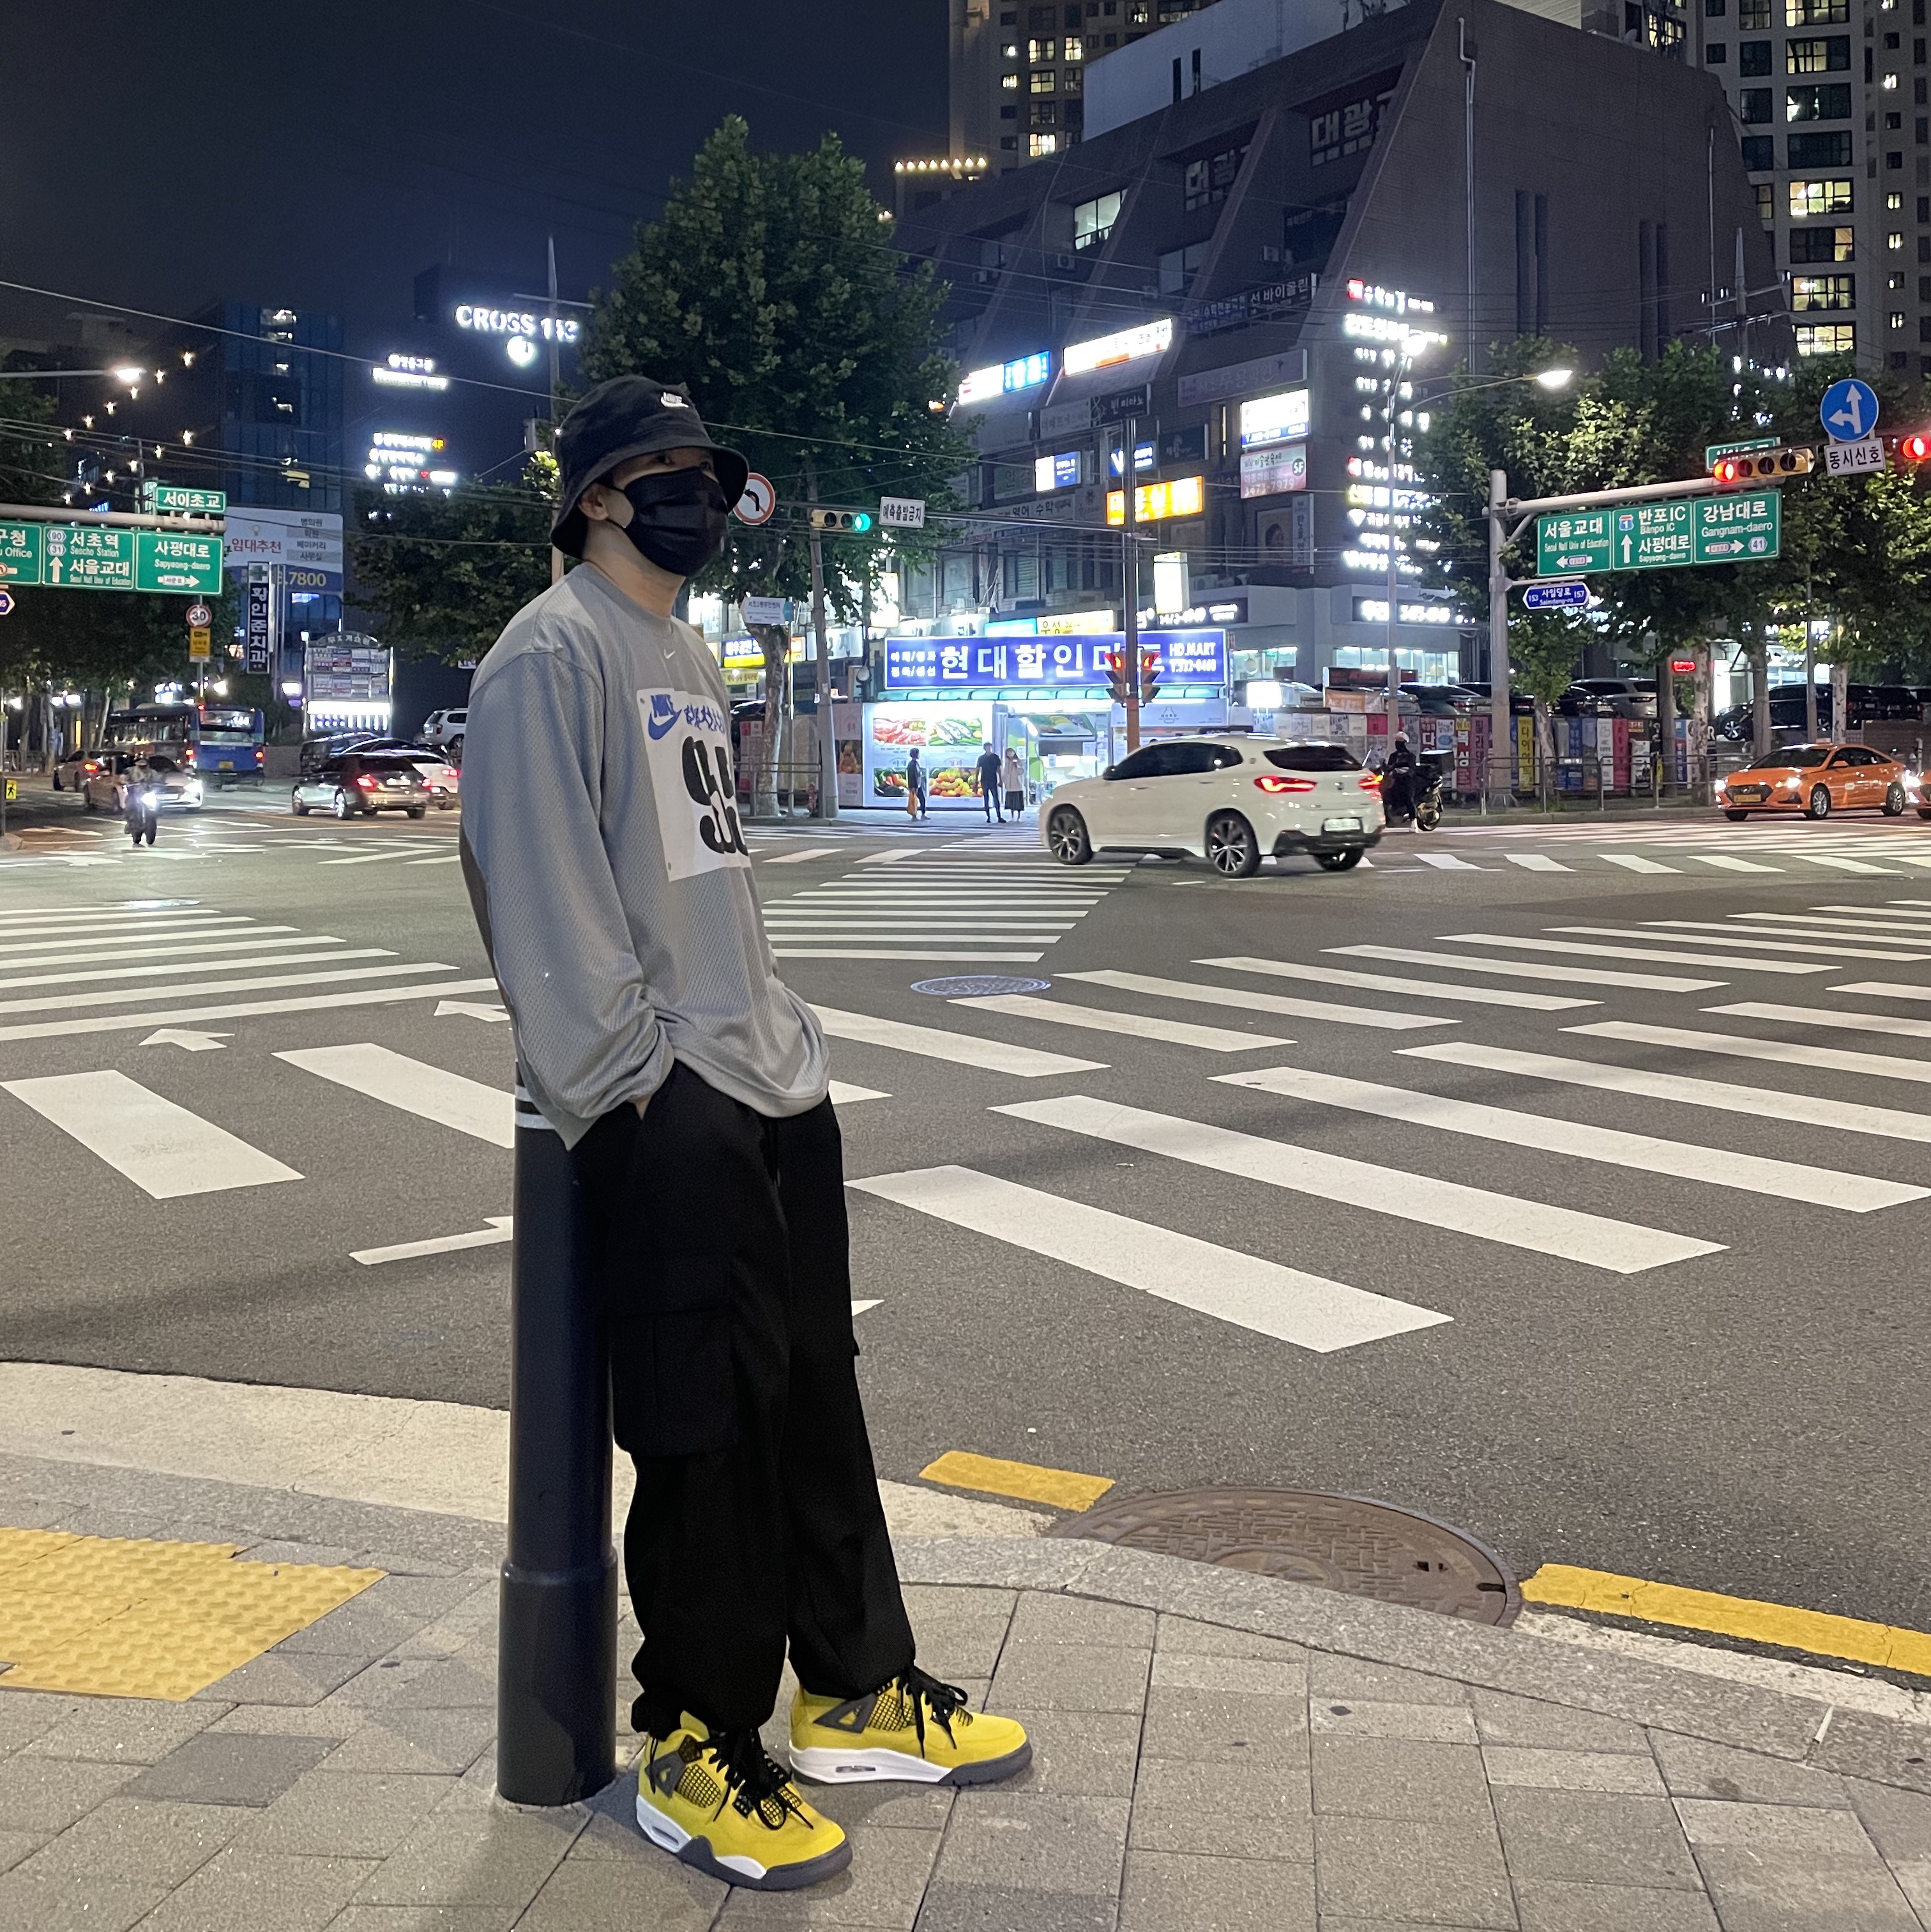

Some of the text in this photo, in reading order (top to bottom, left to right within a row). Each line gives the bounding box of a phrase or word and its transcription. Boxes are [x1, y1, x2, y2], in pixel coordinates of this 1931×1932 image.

[455, 303, 536, 336] CROSS
[1829, 446, 1881, 469] 동시신호
[163, 491, 221, 508] 서이초교
[882, 503, 921, 522] 예측출발금지
[1639, 506, 1686, 526] 반포IC
[1703, 501, 1768, 523] 강남대로
[52, 531, 62, 540] 90
[1544, 516, 1603, 539] 서울교대
[1640, 522, 1675, 535] Banpo IC
[1701, 522, 1773, 538] Gangnam-daero
[70, 531, 119, 549] 서초역
[231, 538, 282, 554] 임대추천
[1544, 543, 1557, 552] Seoul
[1580, 540, 1586, 549] of
[1587, 538, 1609, 549] Education
[1639, 535, 1691, 554] 사평대로
[1752, 539, 1764, 549] 41
[4, 547, 33, 558] Office
[52, 545, 61, 554] 31
[70, 545, 119, 558] Seocho Station
[154, 540, 210, 558] 사평대로
[69, 558, 130, 577] 서울교대
[1541, 587, 1571, 598] 사임당로
[1573, 590, 1584, 598] 157
[192, 611, 206, 621] 30
[1169, 642, 1216, 657] HD.MART
